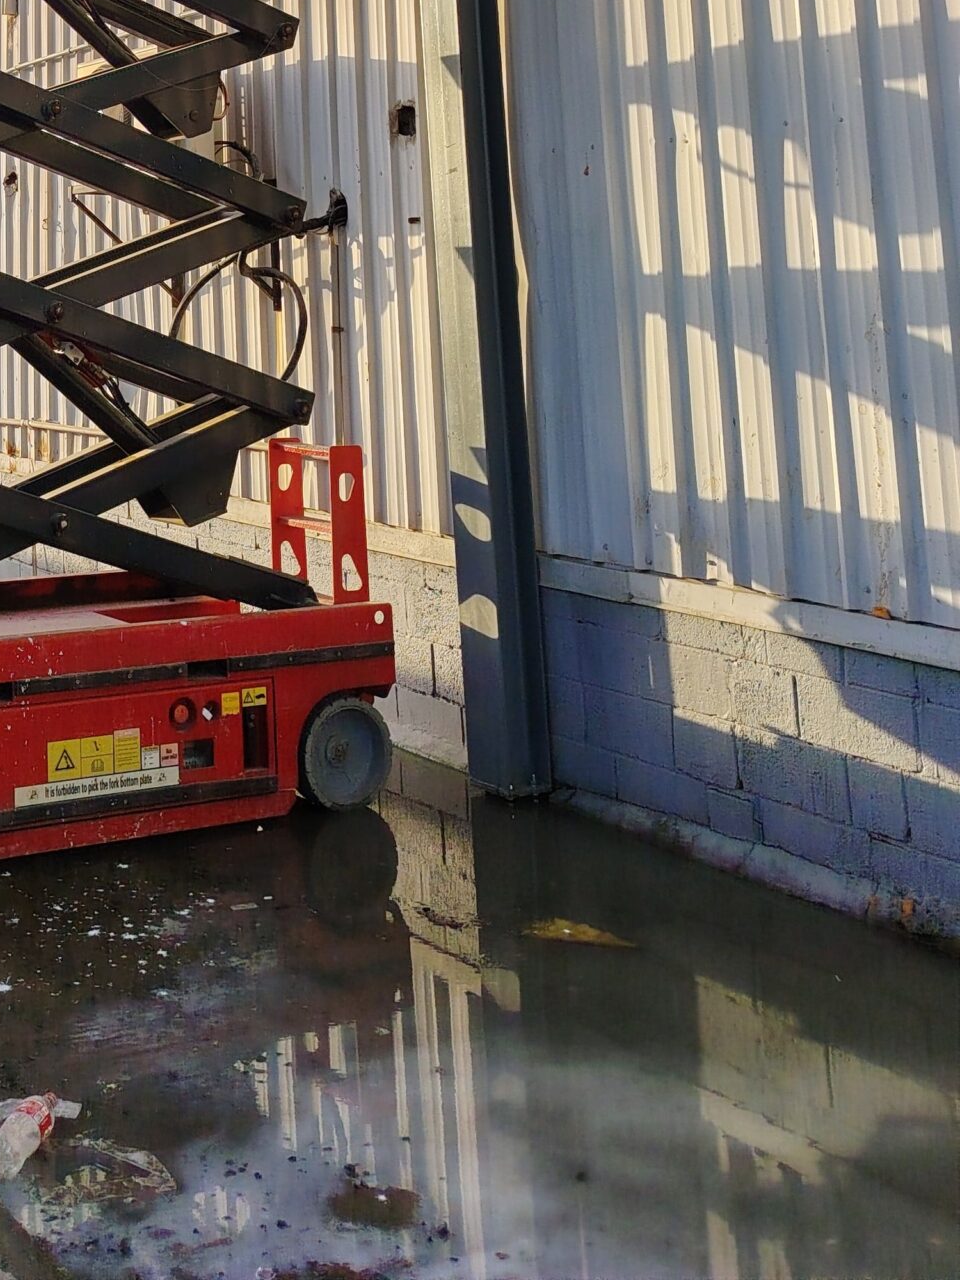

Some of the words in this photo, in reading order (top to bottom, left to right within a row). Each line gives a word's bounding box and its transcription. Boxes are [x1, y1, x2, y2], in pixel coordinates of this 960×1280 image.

[56, 782, 80, 796] forbidden
[81, 782, 87, 793] to
[100, 780, 108, 790] the
[109, 778, 119, 789] fork
[120, 775, 139, 788] bottom
[140, 773, 152, 787] plate
